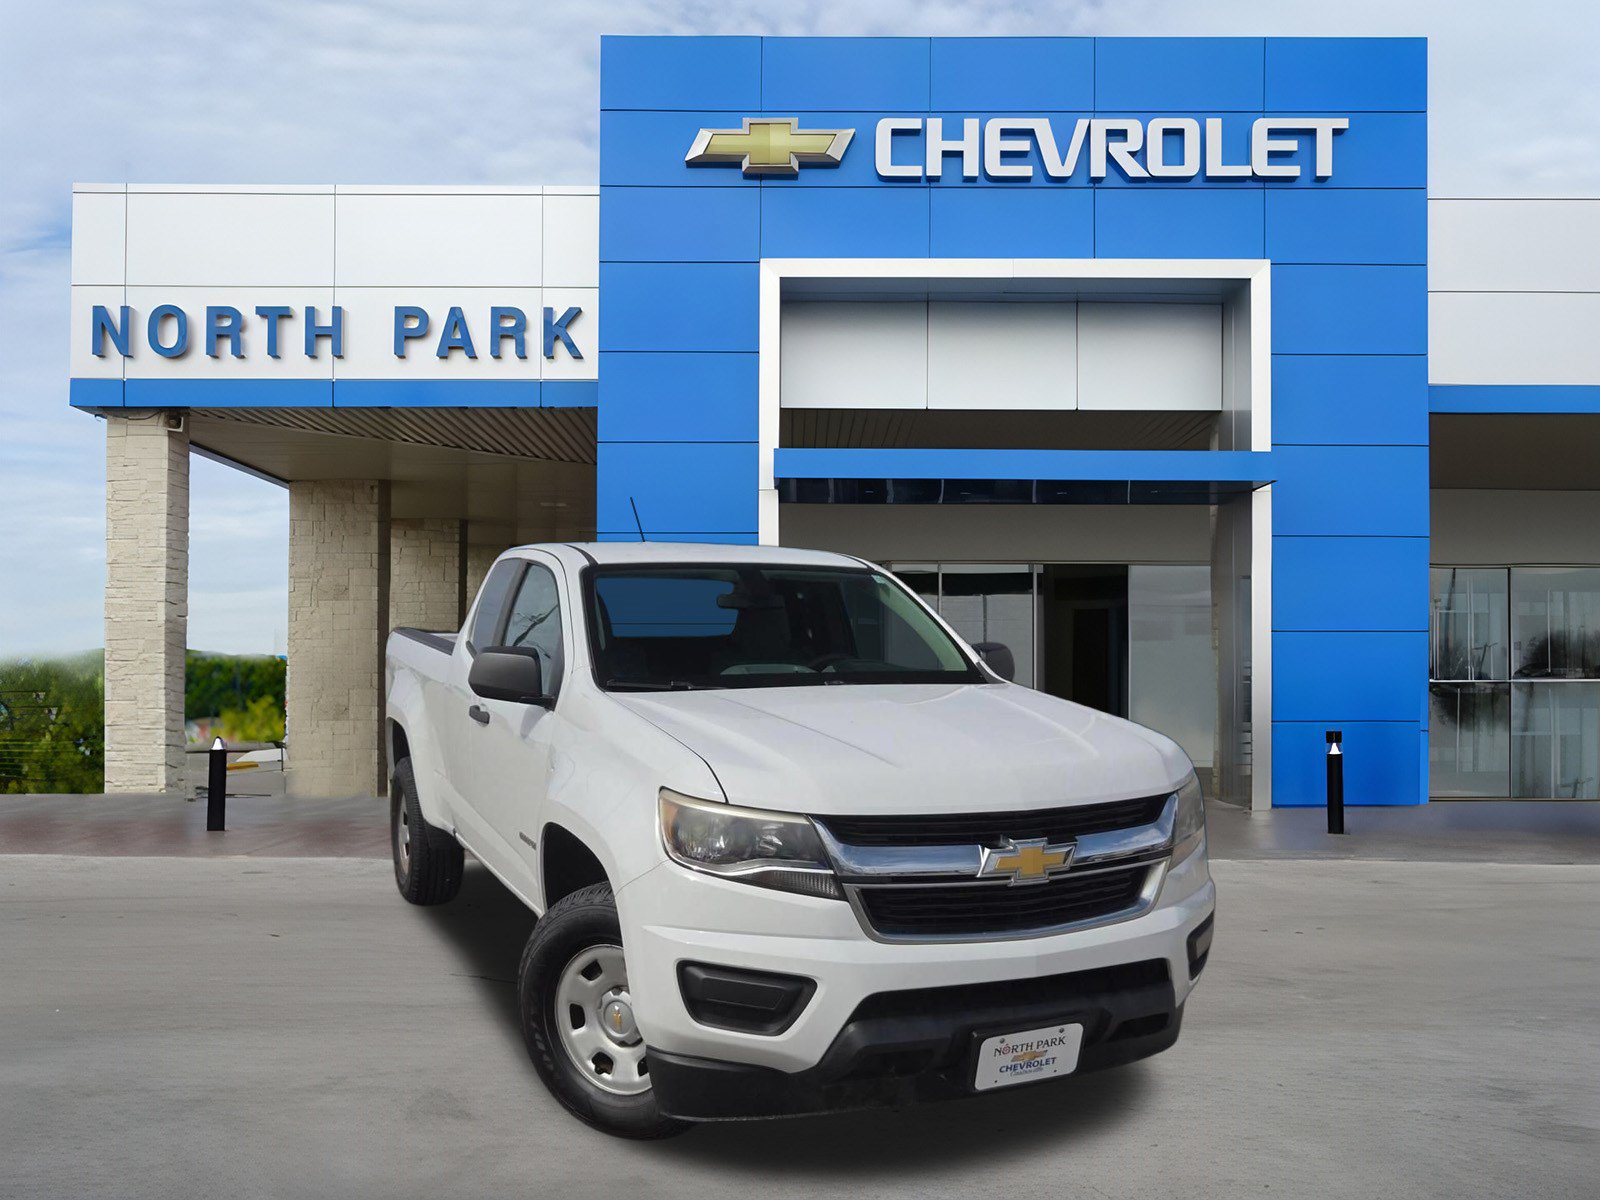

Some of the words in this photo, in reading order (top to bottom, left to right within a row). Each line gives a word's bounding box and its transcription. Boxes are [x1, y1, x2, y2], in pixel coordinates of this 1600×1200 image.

[875, 117, 1350, 179] CHEVROLET
[92, 304, 345, 360] NORTH
[393, 305, 585, 361] PARK
[994, 1042, 1033, 1057] NORTH
[1036, 1036, 1066, 1050] PARK
[999, 1057, 1057, 1073] CHEVROLET
